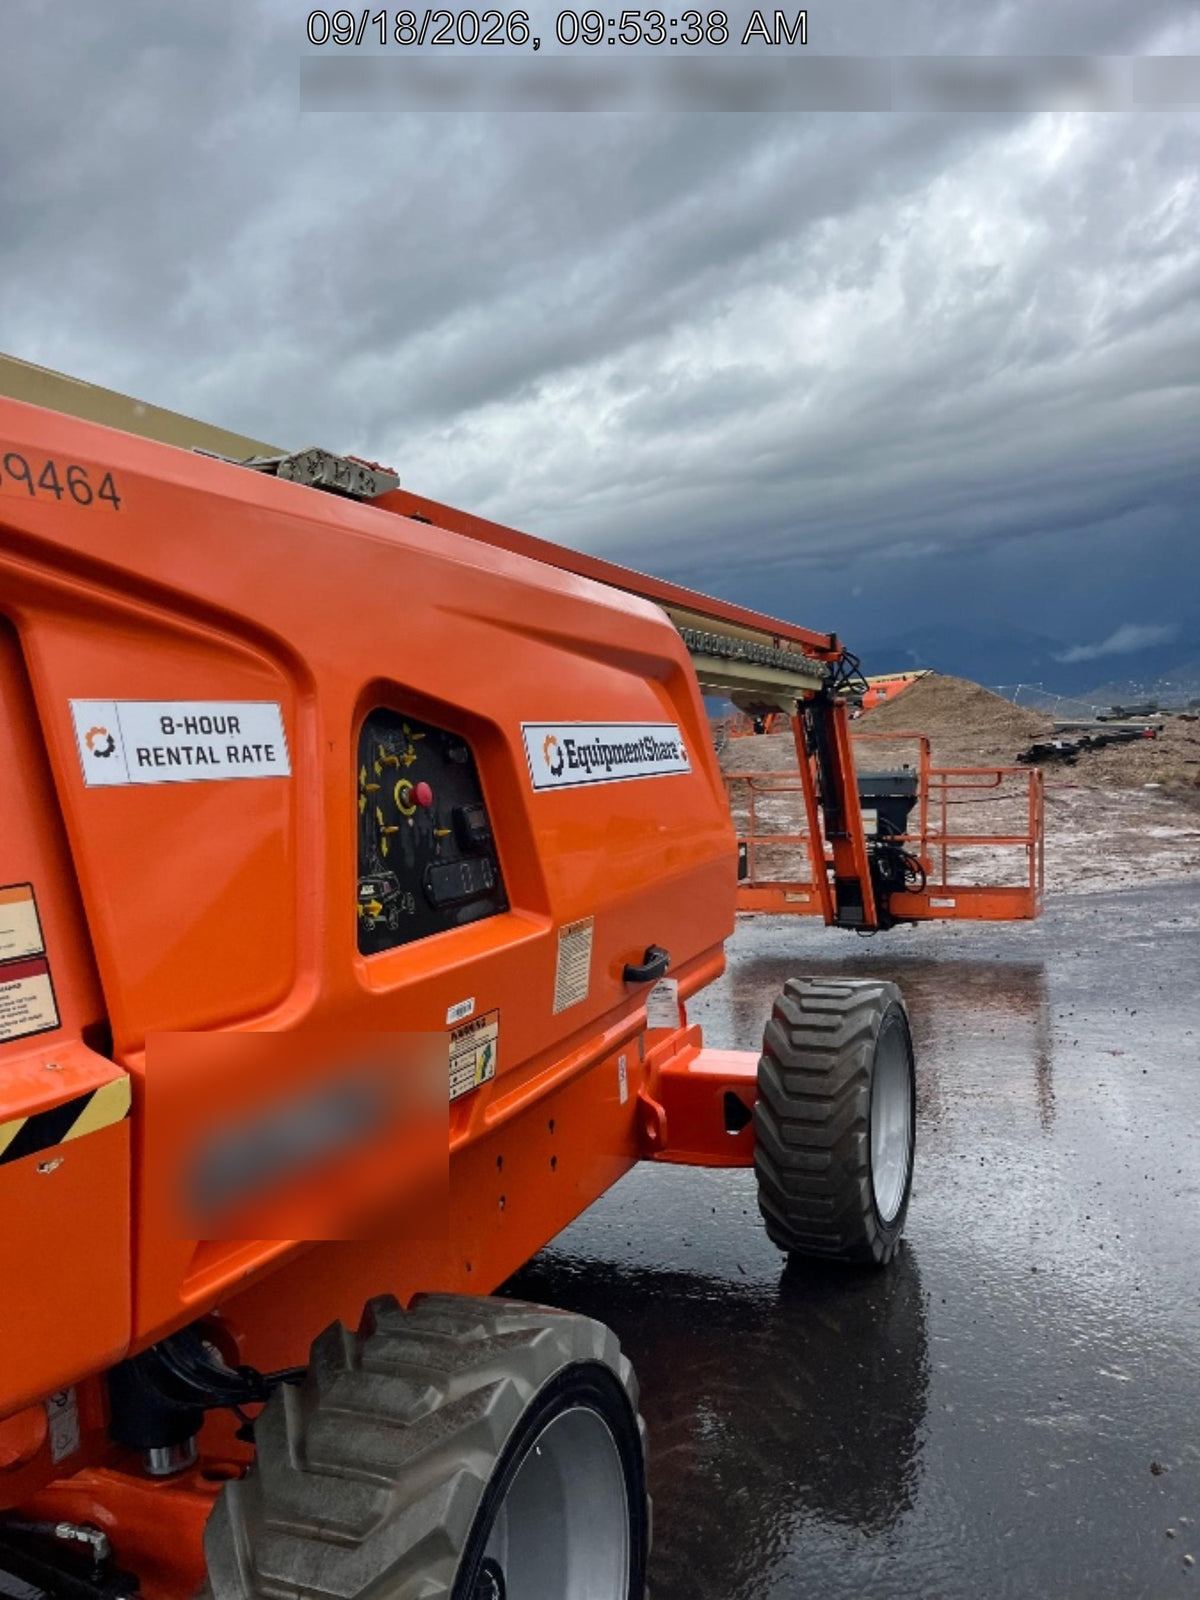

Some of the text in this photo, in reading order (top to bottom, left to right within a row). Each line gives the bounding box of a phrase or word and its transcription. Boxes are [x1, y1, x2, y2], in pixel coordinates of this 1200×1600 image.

[0, 453, 121, 511] 9464
[160, 715, 241, 735] 8-HOUR
[137, 744, 276, 767] RENTAL RATE
[563, 736, 679, 774] EquipmentShare
